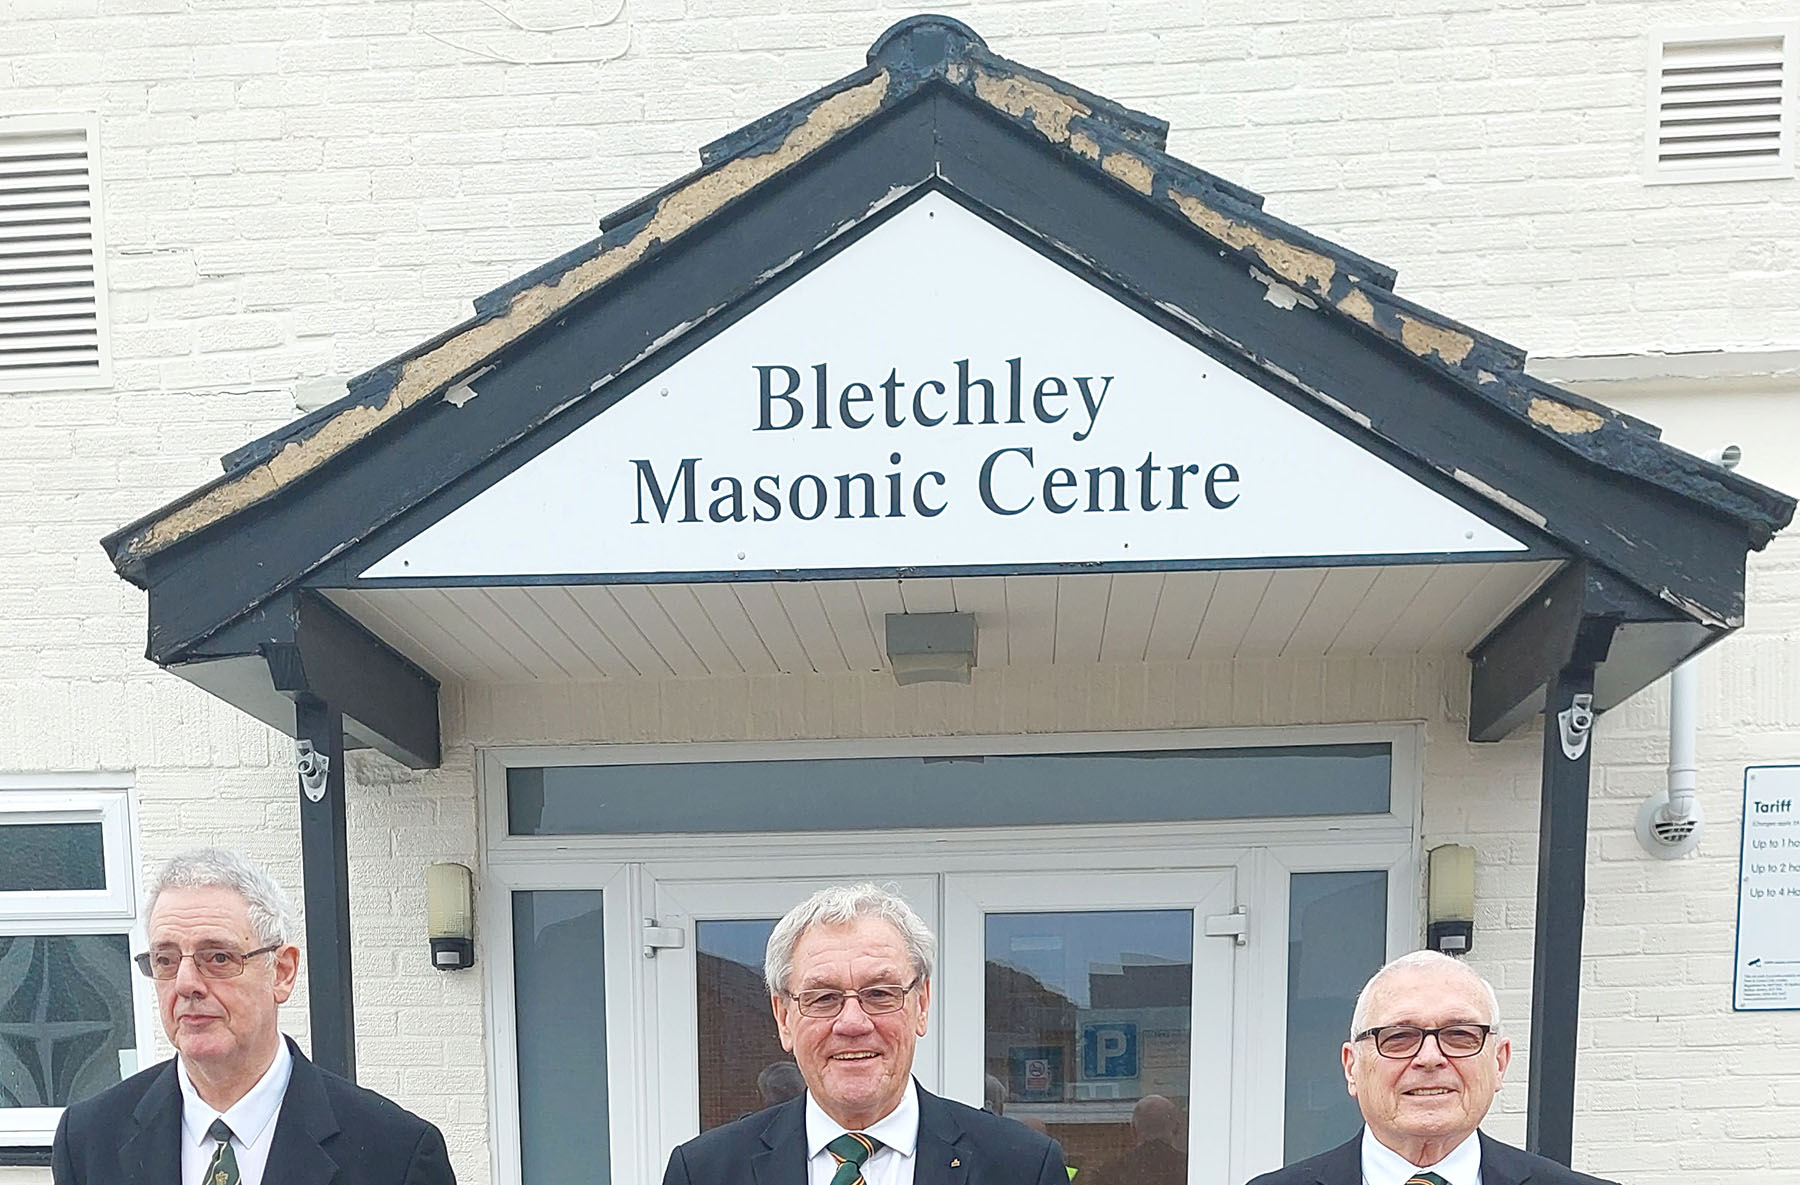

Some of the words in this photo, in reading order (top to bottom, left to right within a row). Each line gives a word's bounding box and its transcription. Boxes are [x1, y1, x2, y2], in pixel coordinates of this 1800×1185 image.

[752, 357, 1114, 442] Bletchley
[629, 452, 949, 524] Masonic
[978, 447, 1240, 515] Centre
[1754, 800, 1792, 813] Tariff
[1752, 839, 1767, 851] Up
[1769, 839, 1779, 849] to
[1781, 838, 1785, 848] 1
[1751, 863, 1766, 875] Up
[1768, 863, 1778, 873] to
[1779, 862, 1787, 873] 2
[1750, 888, 1765, 899] Up
[1766, 888, 1777, 898] to
[1778, 887, 1785, 896] 4
[1097, 1030, 1127, 1075] P
